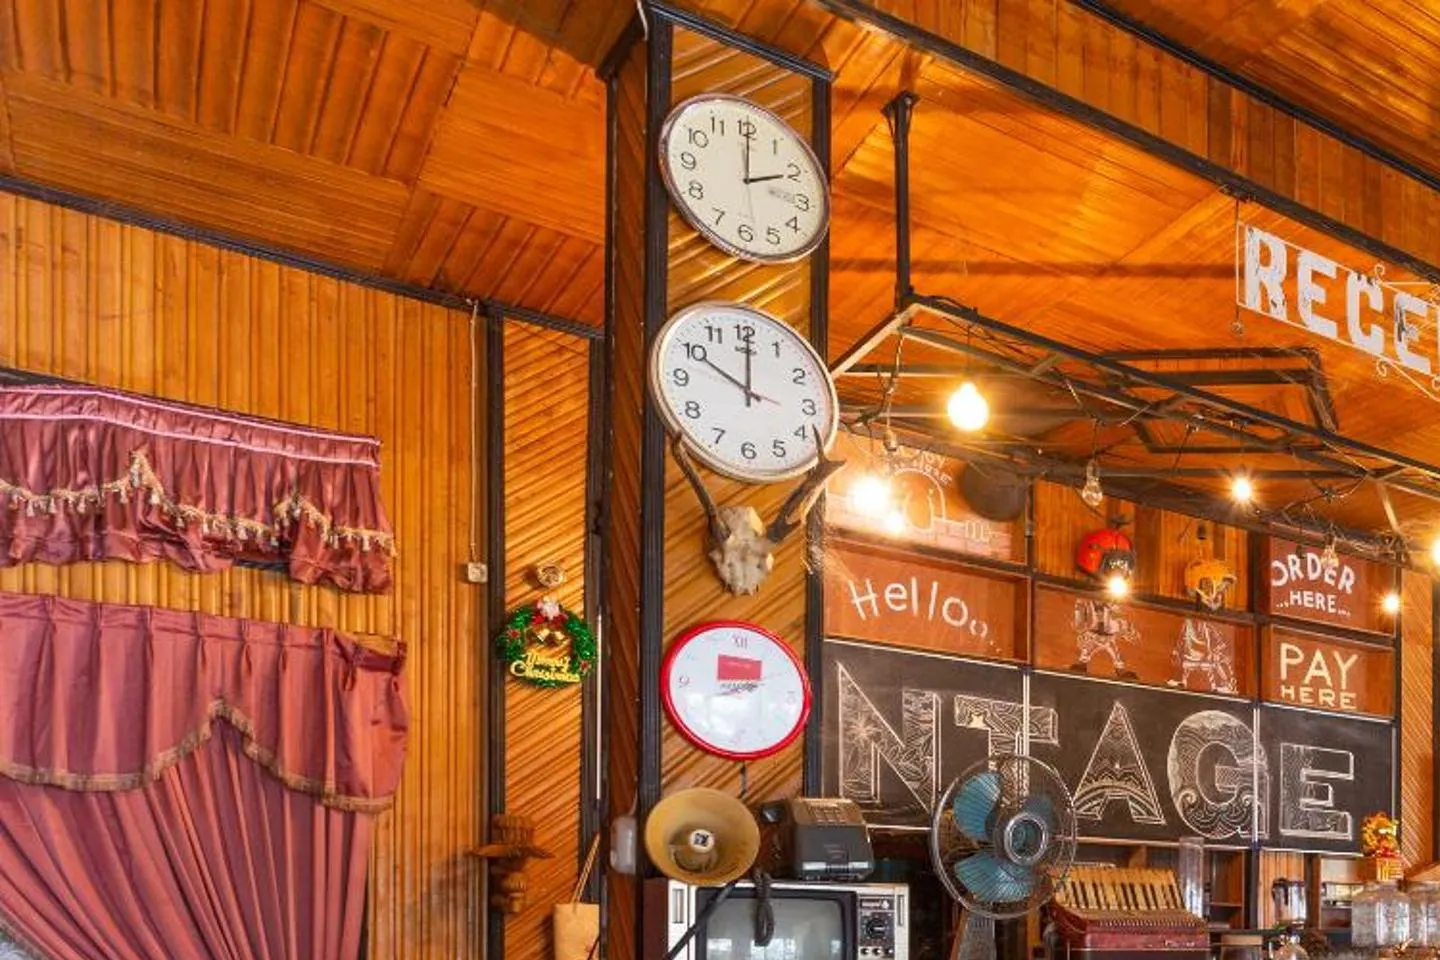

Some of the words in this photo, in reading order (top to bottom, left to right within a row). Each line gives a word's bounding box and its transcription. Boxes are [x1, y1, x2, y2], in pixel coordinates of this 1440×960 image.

[710, 116, 725, 136] 11
[737, 120, 757, 140] 12
[688, 128, 709, 148] 10
[771, 139, 778, 155] 1
[681, 152, 696, 170] 9
[787, 163, 801, 182] 2
[688, 181, 704, 200] 8
[794, 193, 809, 212] 3
[712, 207, 726, 226] 7
[785, 216, 800, 233] 4
[738, 224, 753, 242] 6
[766, 227, 781, 245] 5
[704, 325, 722, 344] 11
[734, 324, 755, 344] 12
[682, 342, 707, 361] 10
[772, 341, 780, 358] 1
[673, 368, 690, 387] 9
[792, 368, 806, 385] 2
[684, 401, 701, 419] 8
[802, 399, 817, 416] 3
[712, 427, 726, 445] 7
[794, 425, 808, 440] 4
[741, 442, 757, 459] 6
[772, 439, 786, 458] 5
[1271, 552, 1355, 594] ORDER
[1280, 642, 1358, 690] PAY
[1280, 685, 1357, 710] HERE
